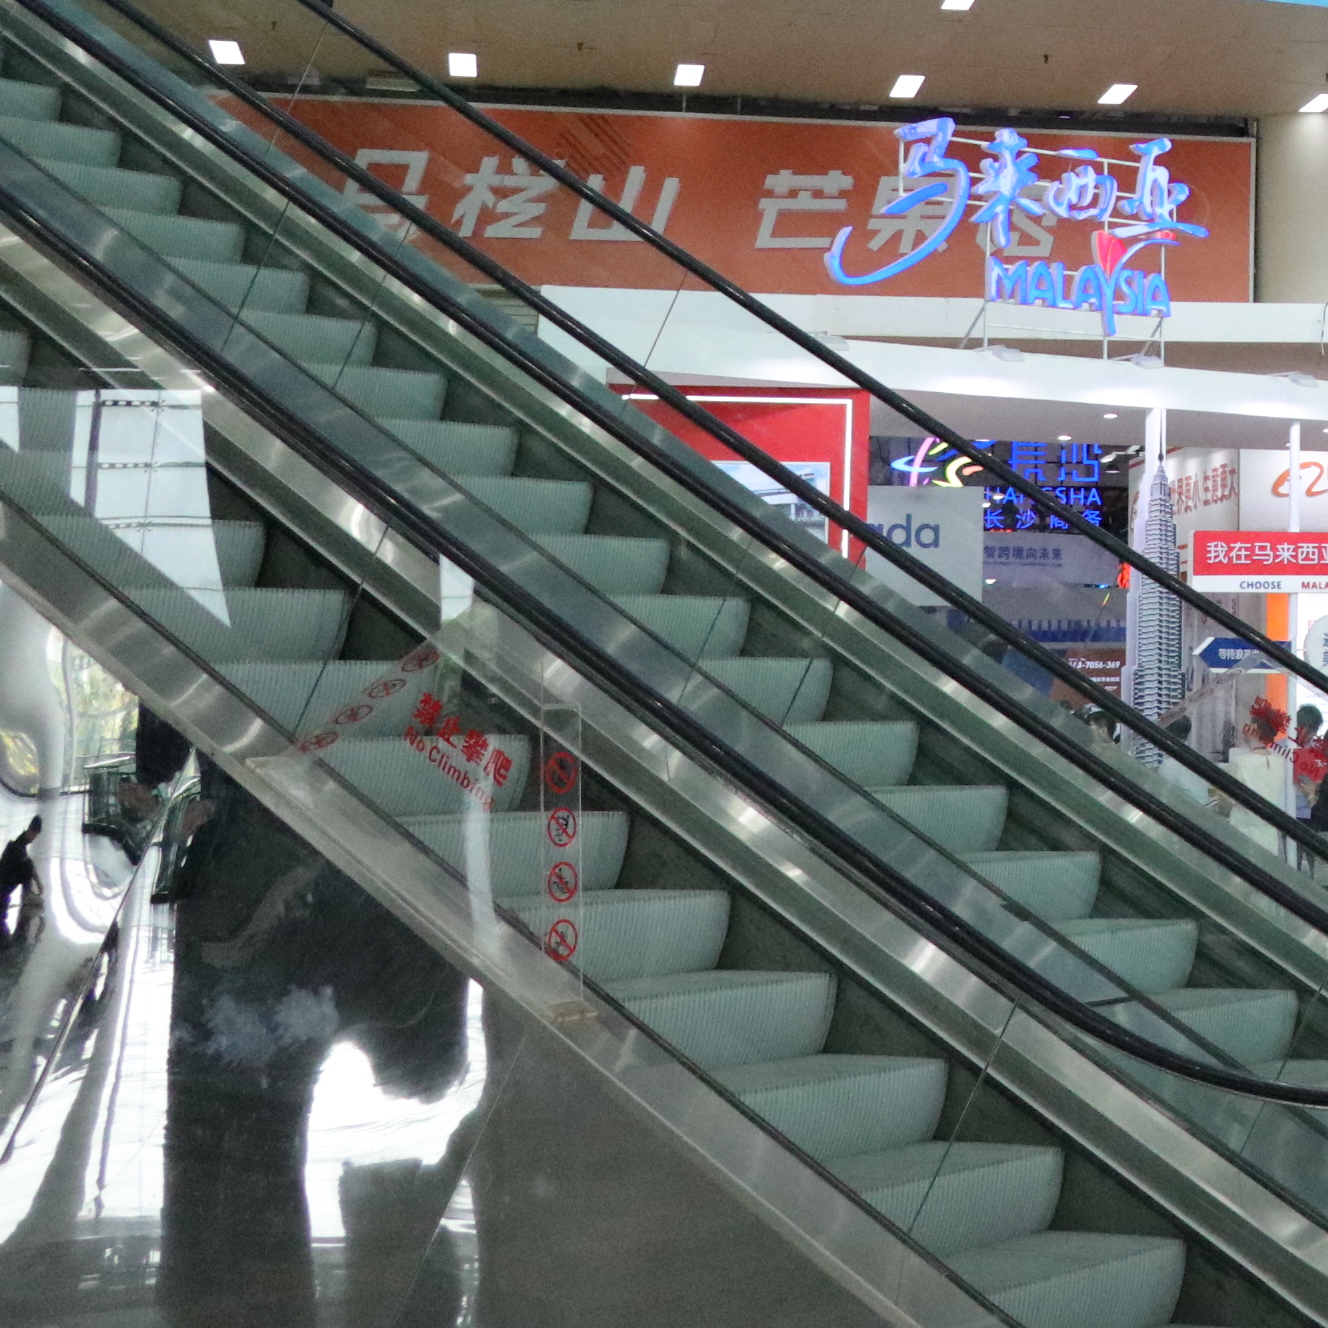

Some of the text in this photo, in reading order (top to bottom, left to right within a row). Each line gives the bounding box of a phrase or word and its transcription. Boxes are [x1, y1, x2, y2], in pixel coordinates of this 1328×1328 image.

[824, 117, 1210, 286] 马来西亚
[987, 238, 1178, 336] MALAYSIA
[1239, 579, 1282, 590] CHOOSE
[402, 724, 497, 812] No Climbing
[413, 691, 515, 789] 禁止攀爬
